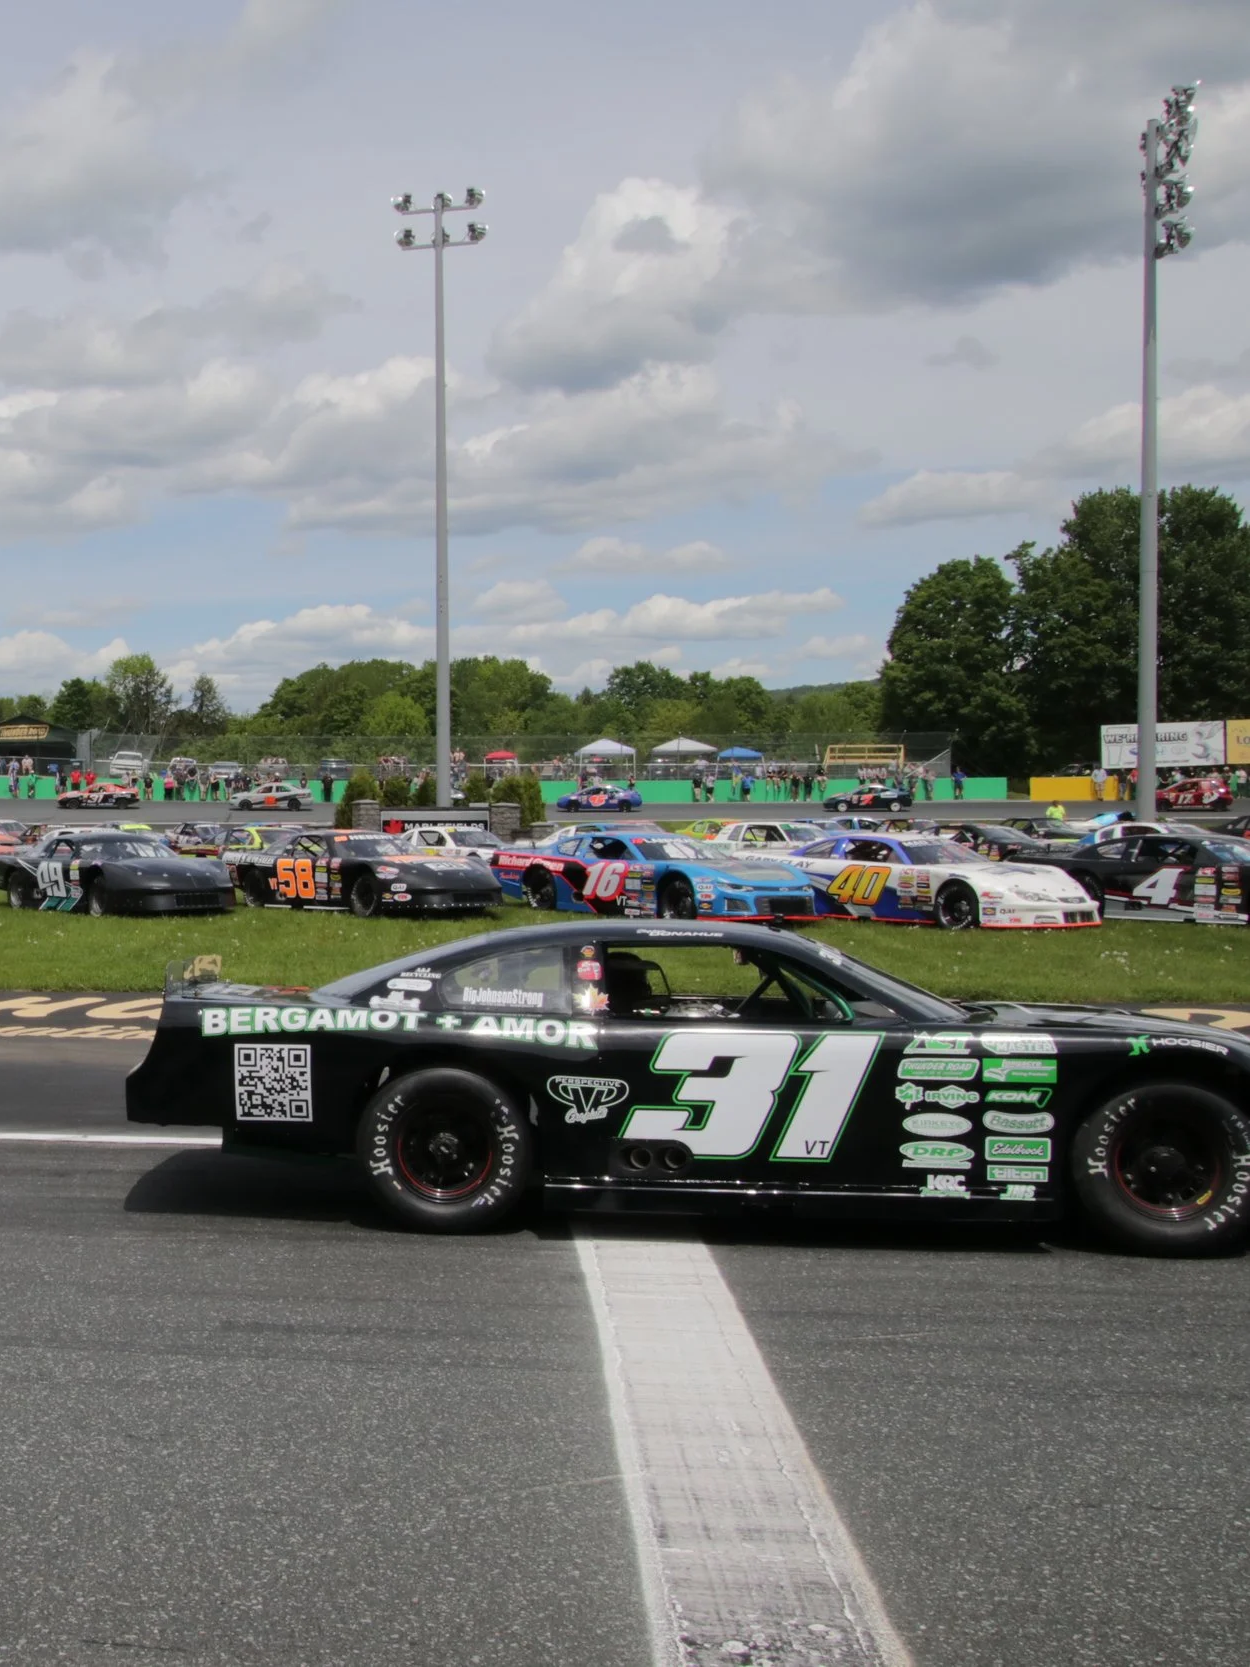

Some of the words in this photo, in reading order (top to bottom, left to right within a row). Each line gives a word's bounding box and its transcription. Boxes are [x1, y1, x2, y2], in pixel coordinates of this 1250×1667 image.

[1155, 732, 1188, 742] RING
[498, 855, 533, 867] Richard
[276, 858, 316, 899] 58
[582, 861, 627, 899] 16
[826, 864, 892, 906] 40
[1132, 867, 1185, 905] 4
[616, 896, 627, 906] VT
[462, 986, 544, 1008] BigJohnsonStrong
[201, 1006, 427, 1037] BERGAMOT
[470, 1015, 599, 1051] AMOR
[1152, 1037, 1230, 1056] HOOSIER
[904, 1062, 948, 1072] THUNDER
[949, 1062, 973, 1072] ROAD
[554, 1076, 622, 1087] PERSPECTIVE
[618, 1030, 886, 1162] 31
[927, 1092, 978, 1101] IRVING
[987, 1091, 1042, 1102] KONI
[369, 1095, 405, 1177] Hoosier
[1087, 1097, 1136, 1179] Hoosier
[804, 1140, 830, 1156] VT
[912, 1146, 965, 1157] DRP
[992, 1143, 1044, 1156] Edelbrock
[480, 1124, 520, 1206] Hoosier
[992, 1167, 1044, 1179] tilton
[926, 1174, 966, 1191] KRC
[1203, 1153, 1250, 1232] Hoosier
